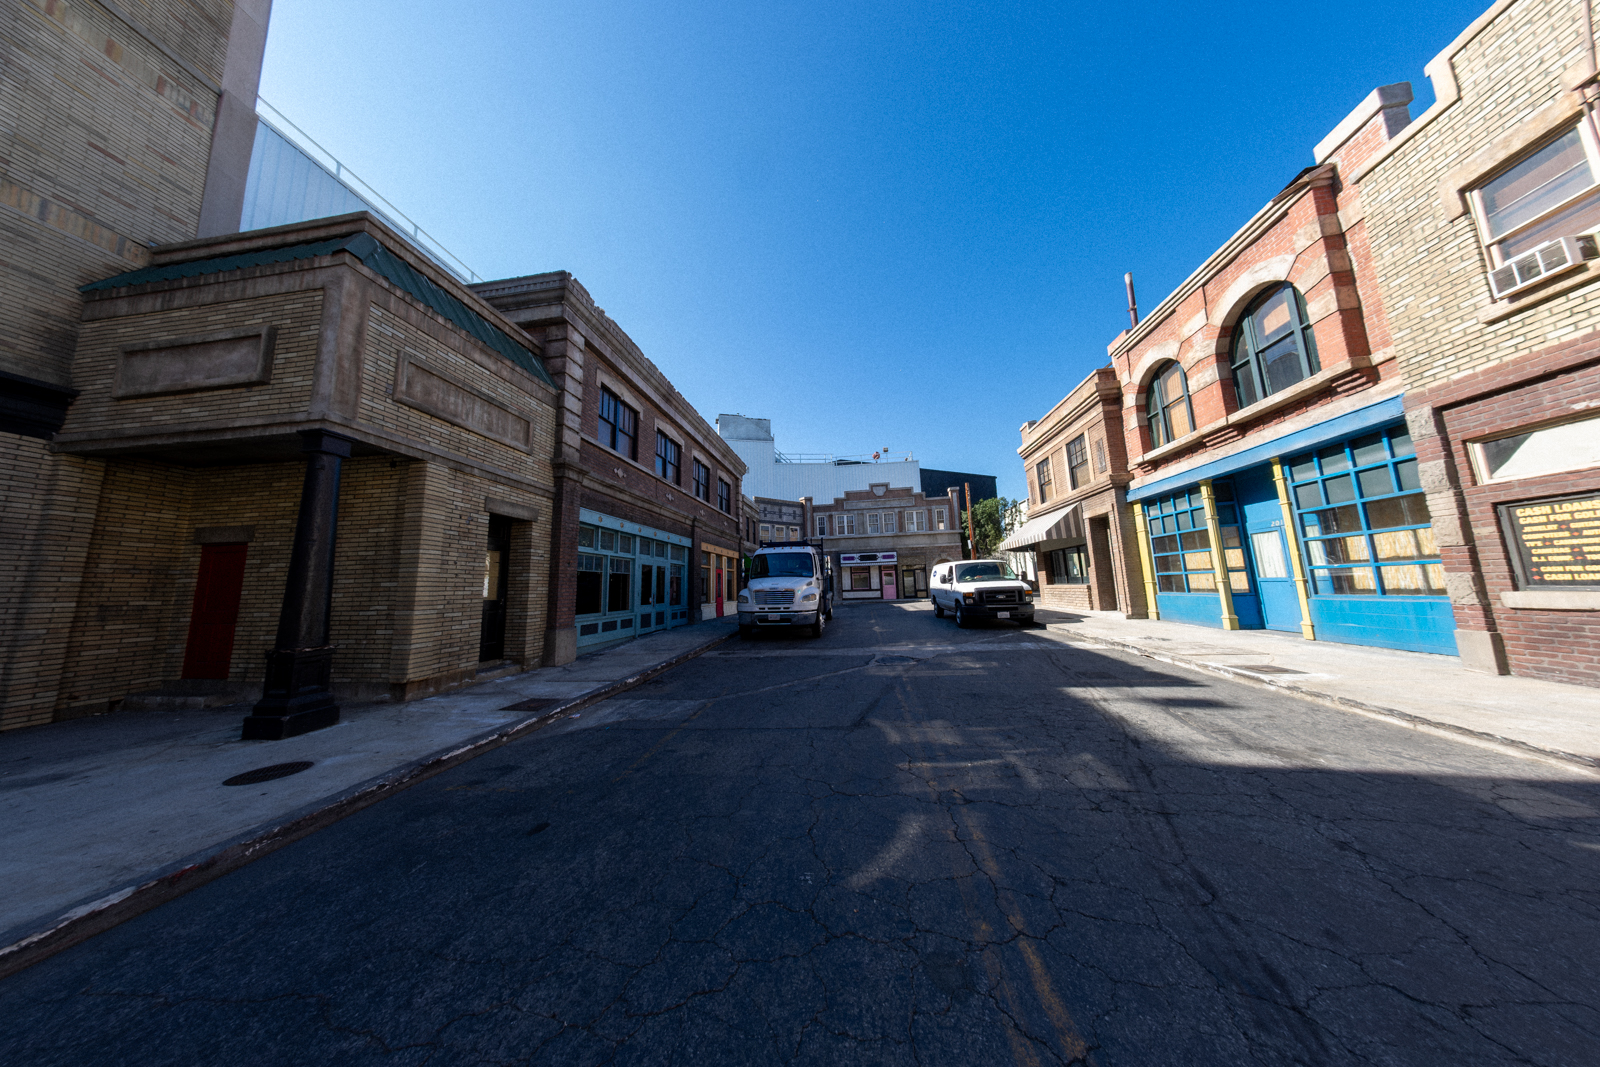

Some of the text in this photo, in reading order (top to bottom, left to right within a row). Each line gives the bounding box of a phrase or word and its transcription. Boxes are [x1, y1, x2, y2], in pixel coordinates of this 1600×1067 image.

[1516, 500, 1600, 517] CASH LOANS
[1519, 515, 1548, 524] CASH
[1548, 513, 1572, 521] FOR
[1522, 524, 1558, 532] JEWELRY
[1522, 531, 1571, 540] COMPUTERS
